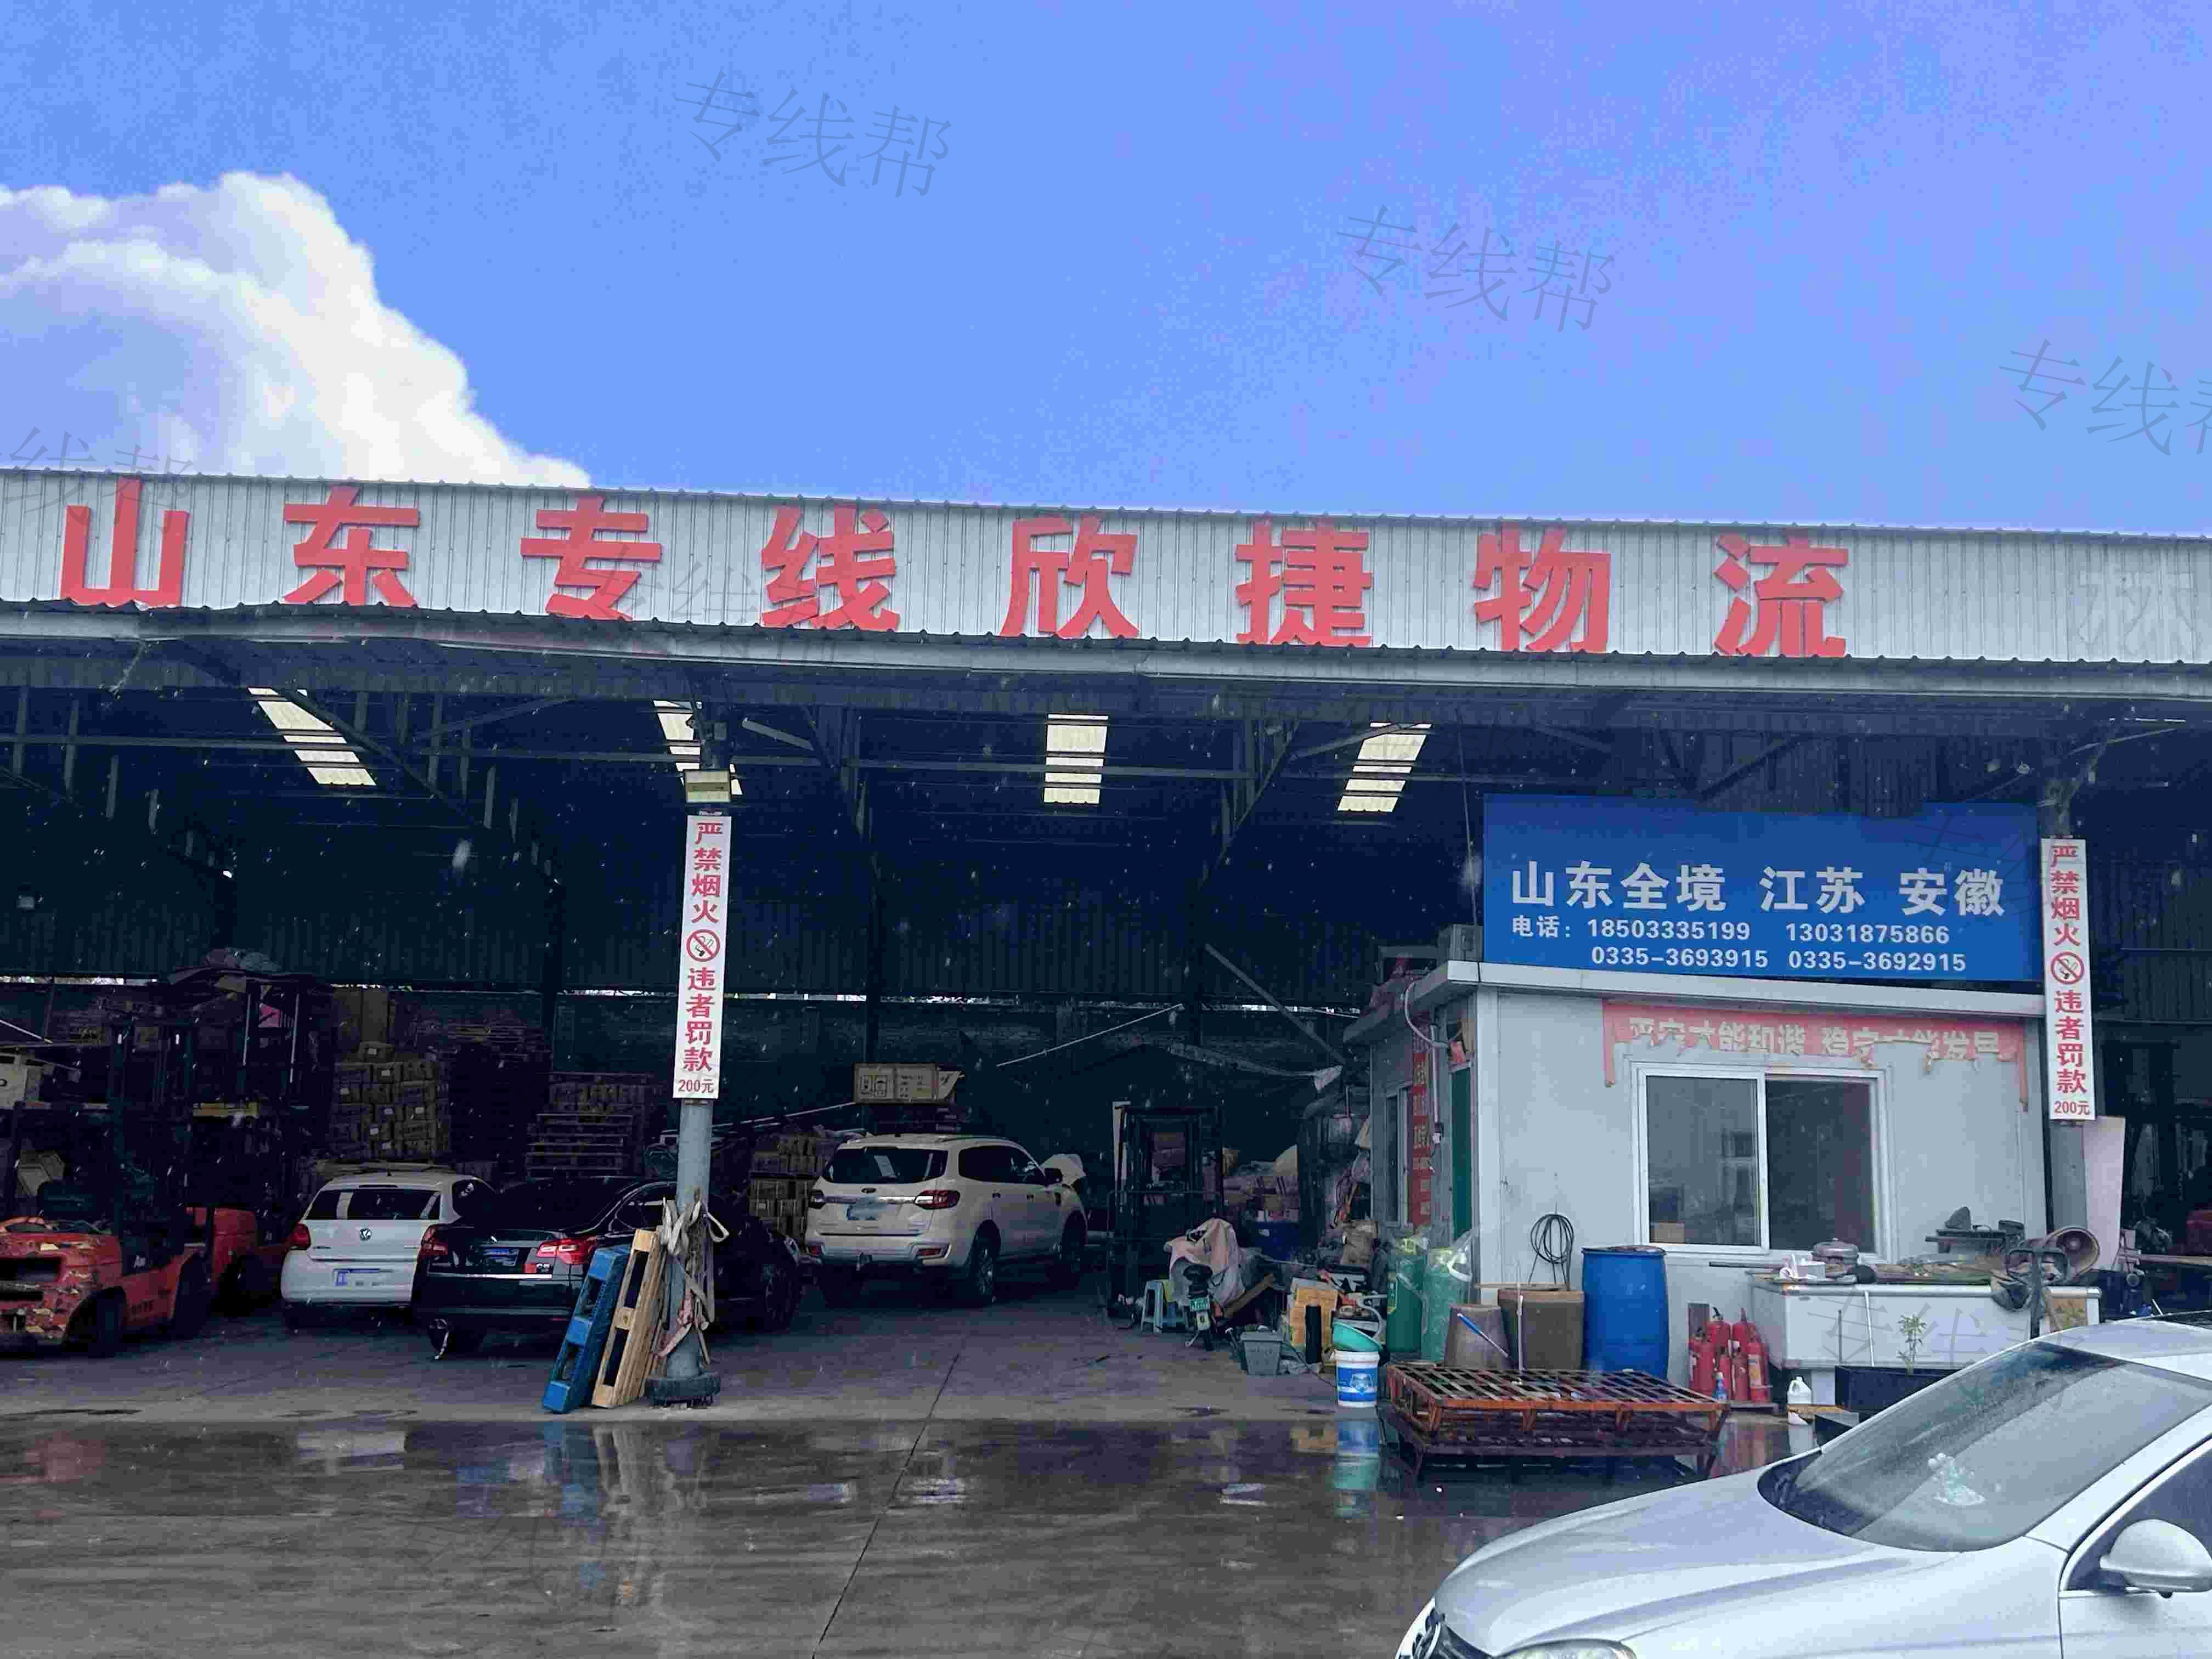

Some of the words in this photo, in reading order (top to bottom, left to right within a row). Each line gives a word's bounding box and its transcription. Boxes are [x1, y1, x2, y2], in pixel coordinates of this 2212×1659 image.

[59, 476, 1849, 659] 山东专线欣捷物流
[691, 822, 723, 924] 严禁烟火
[1511, 860, 1726, 912] 山东全境
[1759, 866, 1865, 913] 江苏
[1898, 867, 2005, 917] 安徽
[2051, 845, 2081, 946] 严禁烟火
[1587, 919, 1751, 941] 18503335199
[1785, 922, 1950, 944] 13031875866
[1591, 946, 1769, 968] 0335-3693915
[1788, 950, 1967, 972] 0335-3692915
[682, 967, 716, 1072] 违者罚款
[2054, 990, 2087, 1093] 违者罚款
[678, 1078, 715, 1094] 200元
[2053, 1100, 2090, 1116] 200元
